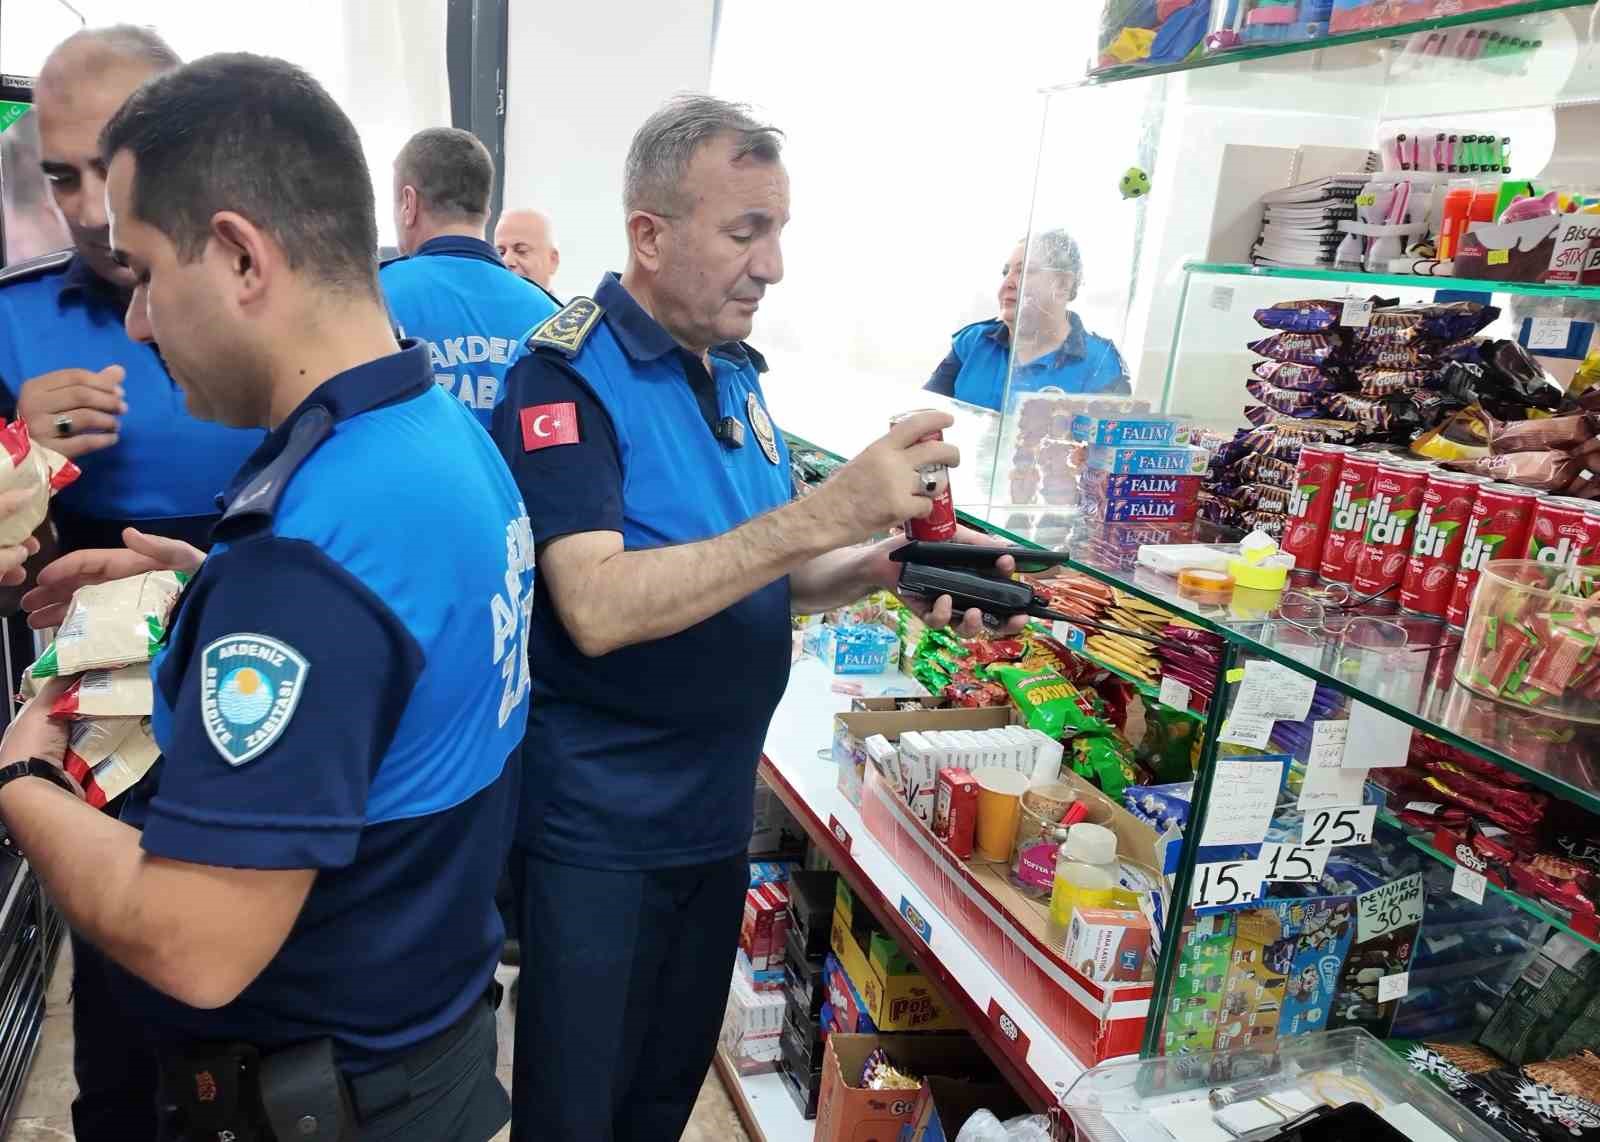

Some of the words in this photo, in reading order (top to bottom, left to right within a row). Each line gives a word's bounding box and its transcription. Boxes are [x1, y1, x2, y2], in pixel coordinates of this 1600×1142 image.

[1379, 351, 1410, 362] Gong
[1122, 427, 1168, 440] FALIM
[1139, 456, 1184, 469] FALIM
[1131, 480, 1177, 492] FALIM
[1129, 504, 1176, 516] FALIM
[219, 643, 287, 667] AKDENİZ
[1305, 810, 1361, 846] 25
[1265, 846, 1315, 880] 15
[1193, 864, 1244, 906] 15
[1370, 905, 1402, 933] 30
